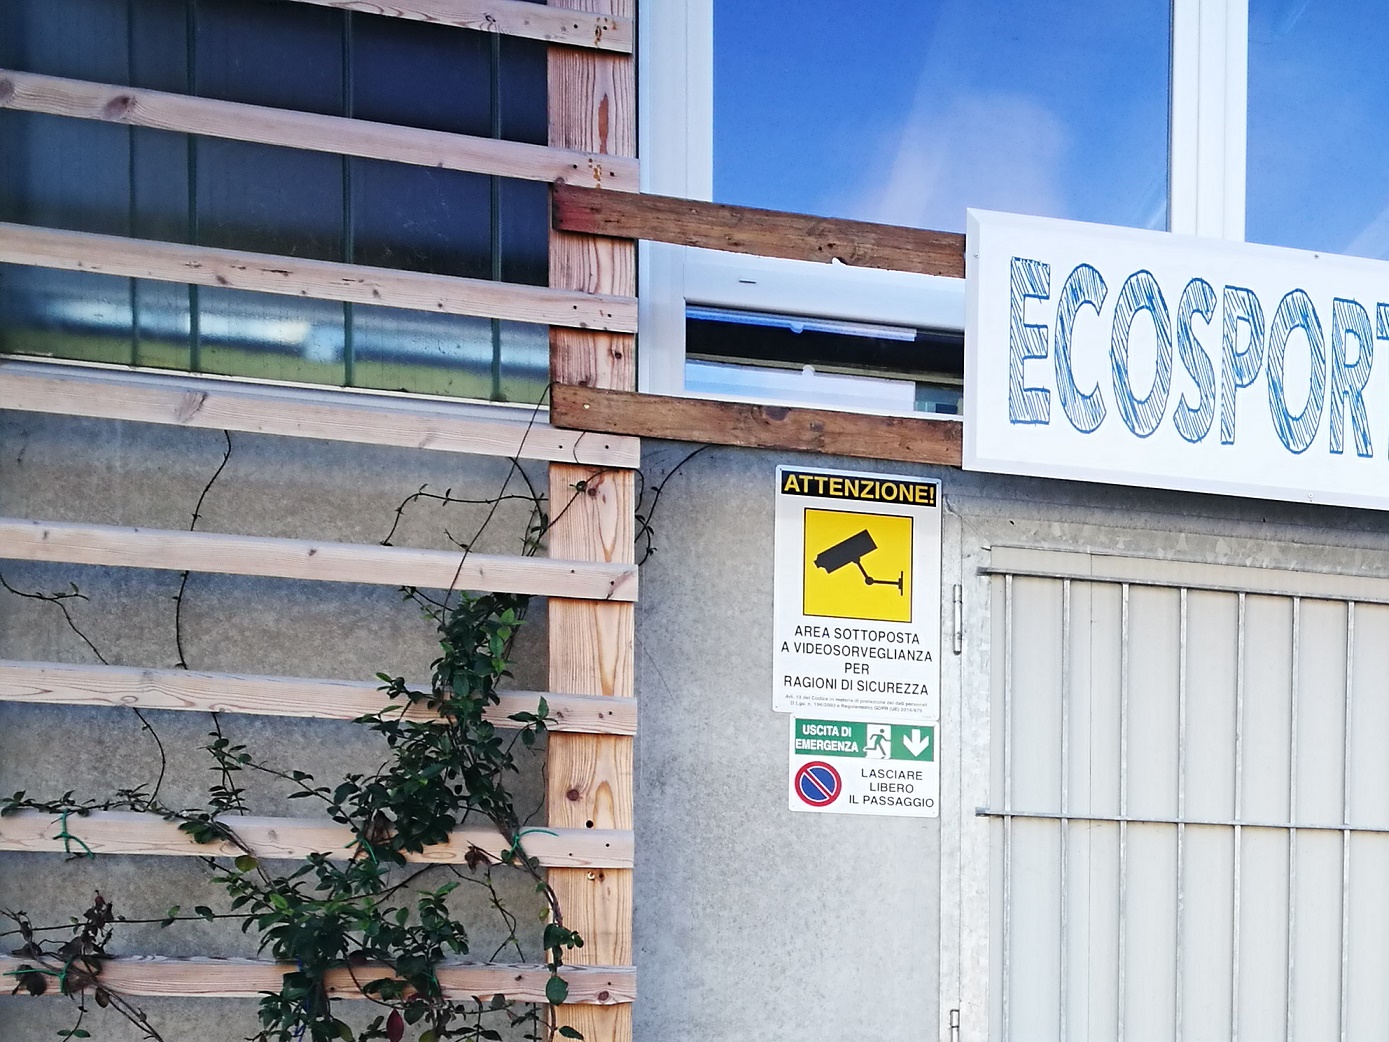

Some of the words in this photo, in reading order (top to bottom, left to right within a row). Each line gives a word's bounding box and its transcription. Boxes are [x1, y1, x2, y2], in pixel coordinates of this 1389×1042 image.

[784, 474, 934, 504] ATTENZIONE!
[794, 625, 830, 638] AREA
[834, 627, 920, 645] SOTTOPOSTA
[781, 641, 790, 653] A
[794, 642, 932, 662] VIDEOSORVEGLIANZA
[844, 662, 870, 675] PER
[784, 675, 837, 690] RAGIONI
[841, 679, 853, 691] DI
[857, 680, 928, 695] SICUREZZA
[802, 724, 838, 737] USCITA
[841, 727, 852, 737] DI
[795, 739, 859, 753] EMERGENZA
[861, 768, 923, 781] LASCIARE
[869, 782, 914, 793] LIBERO
[849, 795, 859, 804] IL
[863, 795, 934, 808] PASSAGGIO
